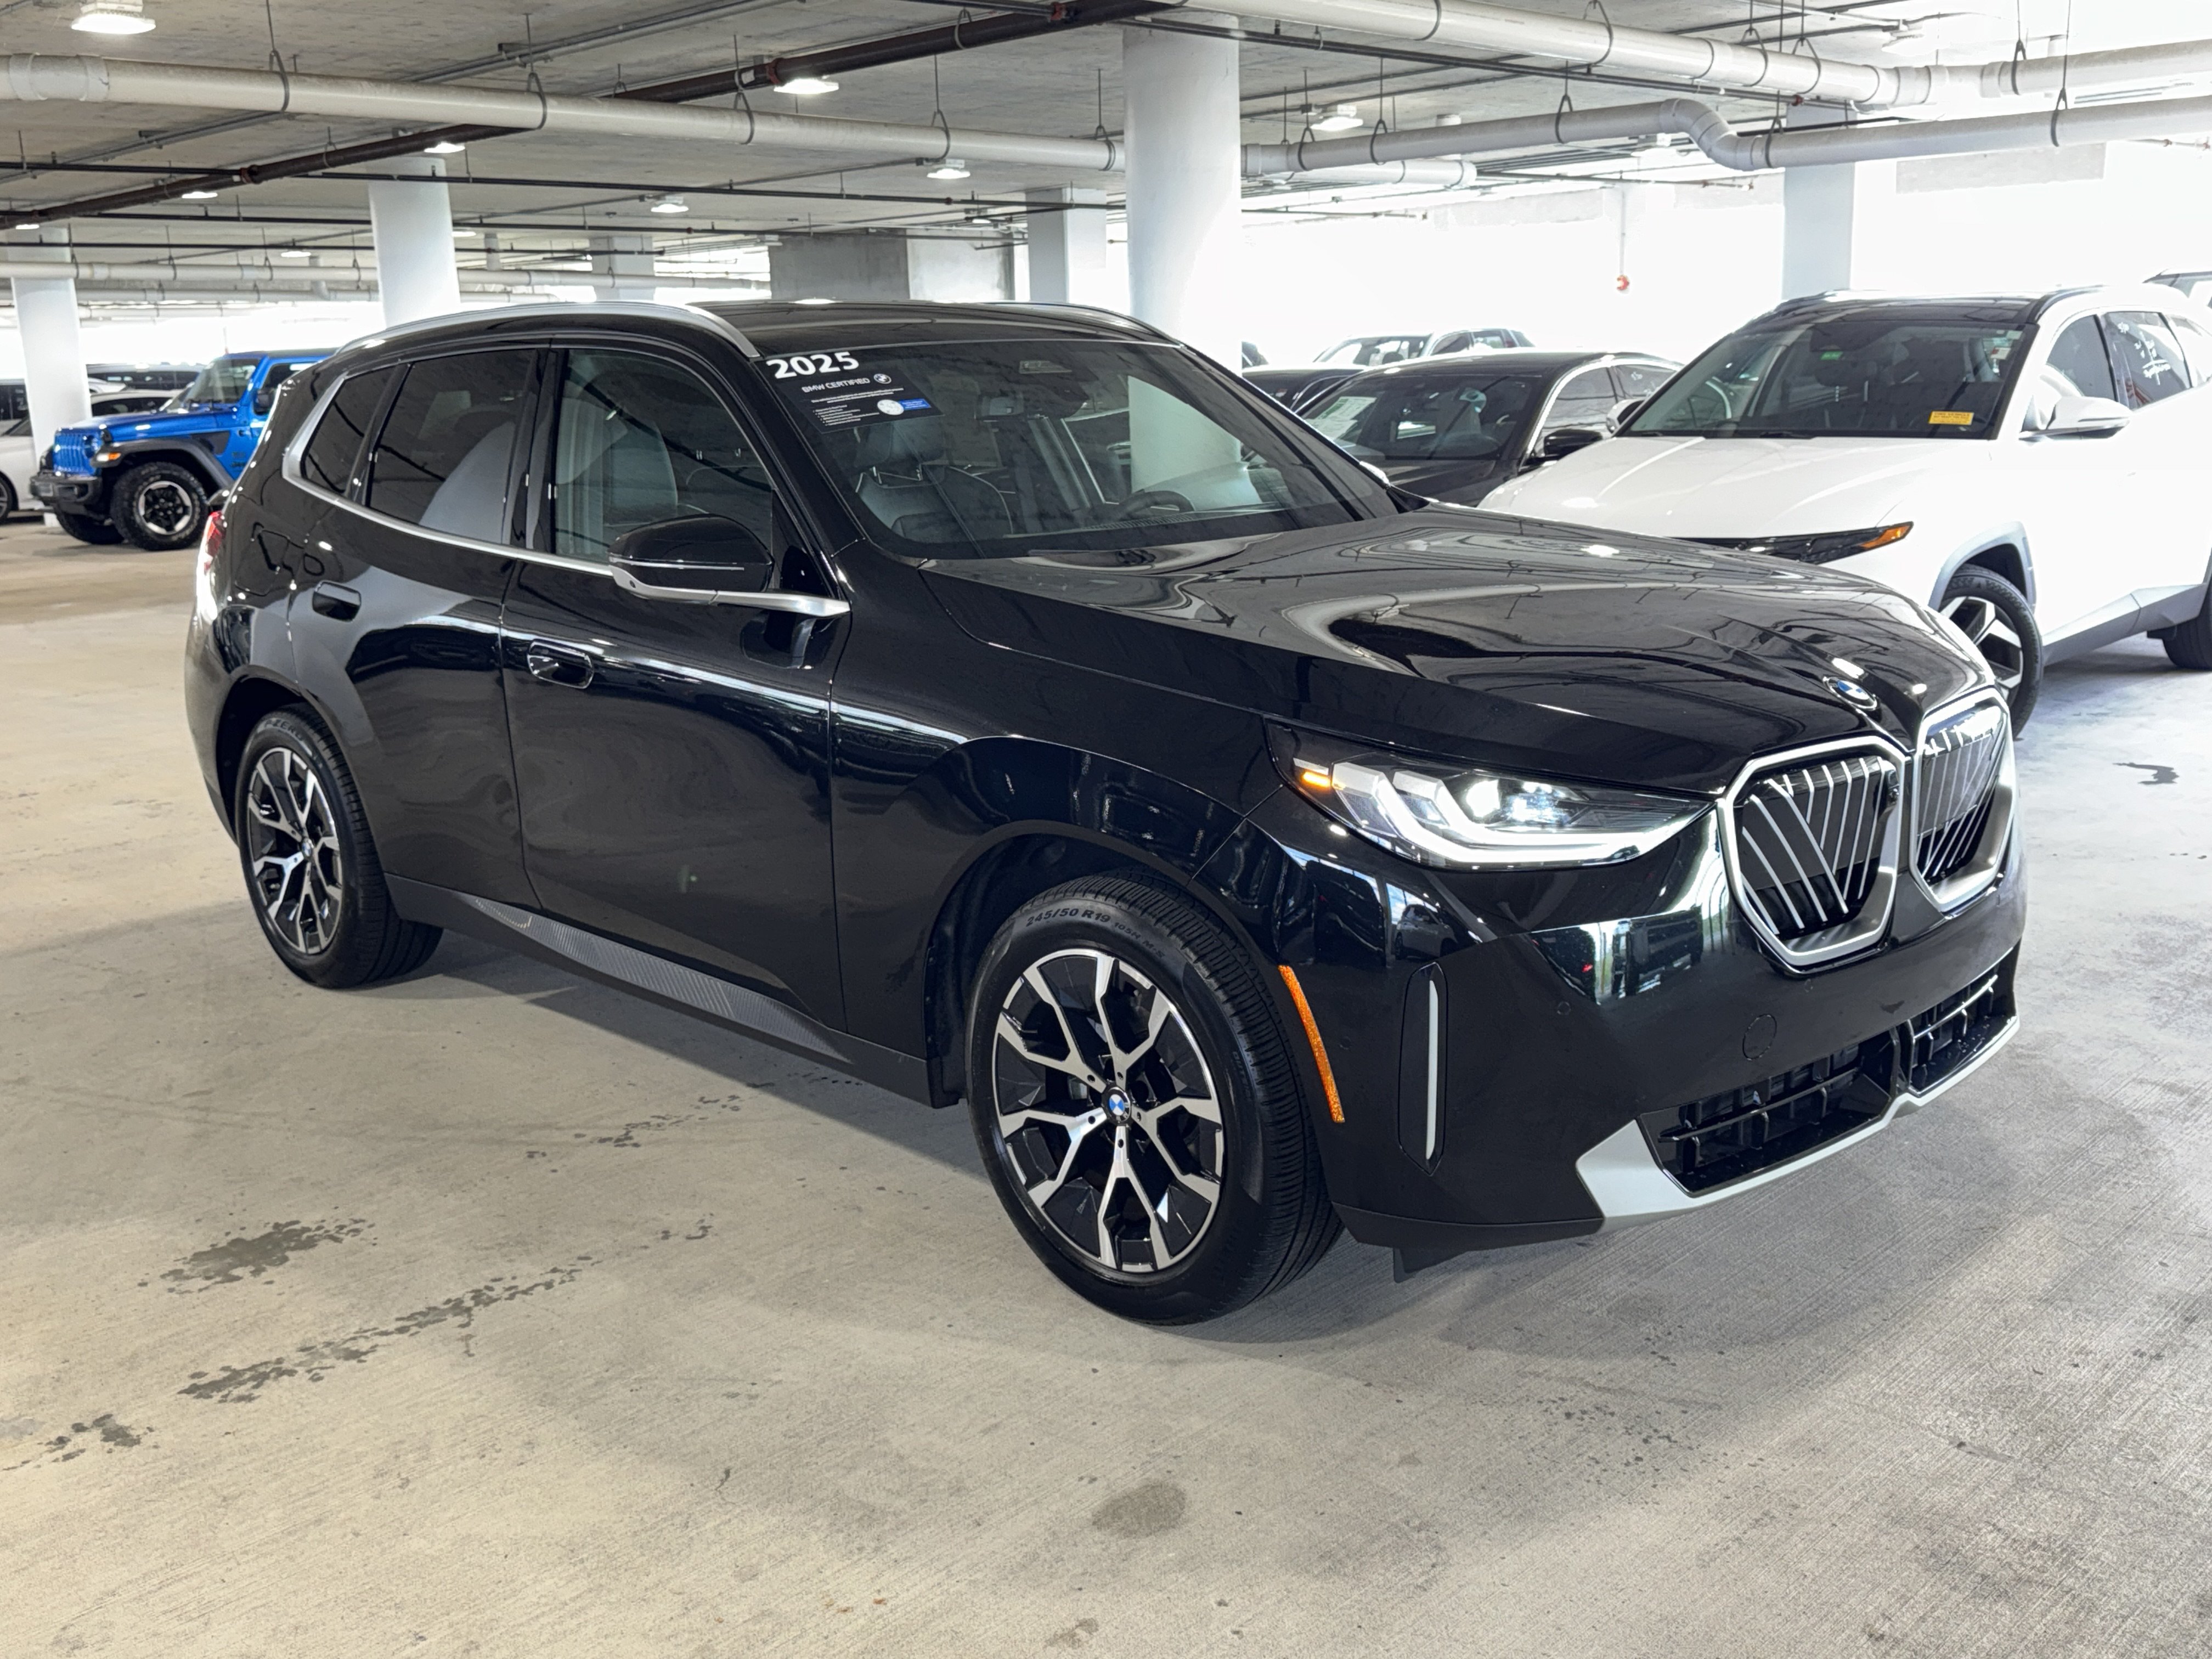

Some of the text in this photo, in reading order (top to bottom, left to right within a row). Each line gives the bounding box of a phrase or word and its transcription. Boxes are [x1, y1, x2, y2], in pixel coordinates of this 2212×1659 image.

[766, 352, 859, 379] 2025
[802, 378, 871, 393] BMW CERTIFIED
[1026, 908, 1079, 927] 245/50
[1081, 910, 1111, 923] R19
[1115, 922, 1142, 939] 105H
